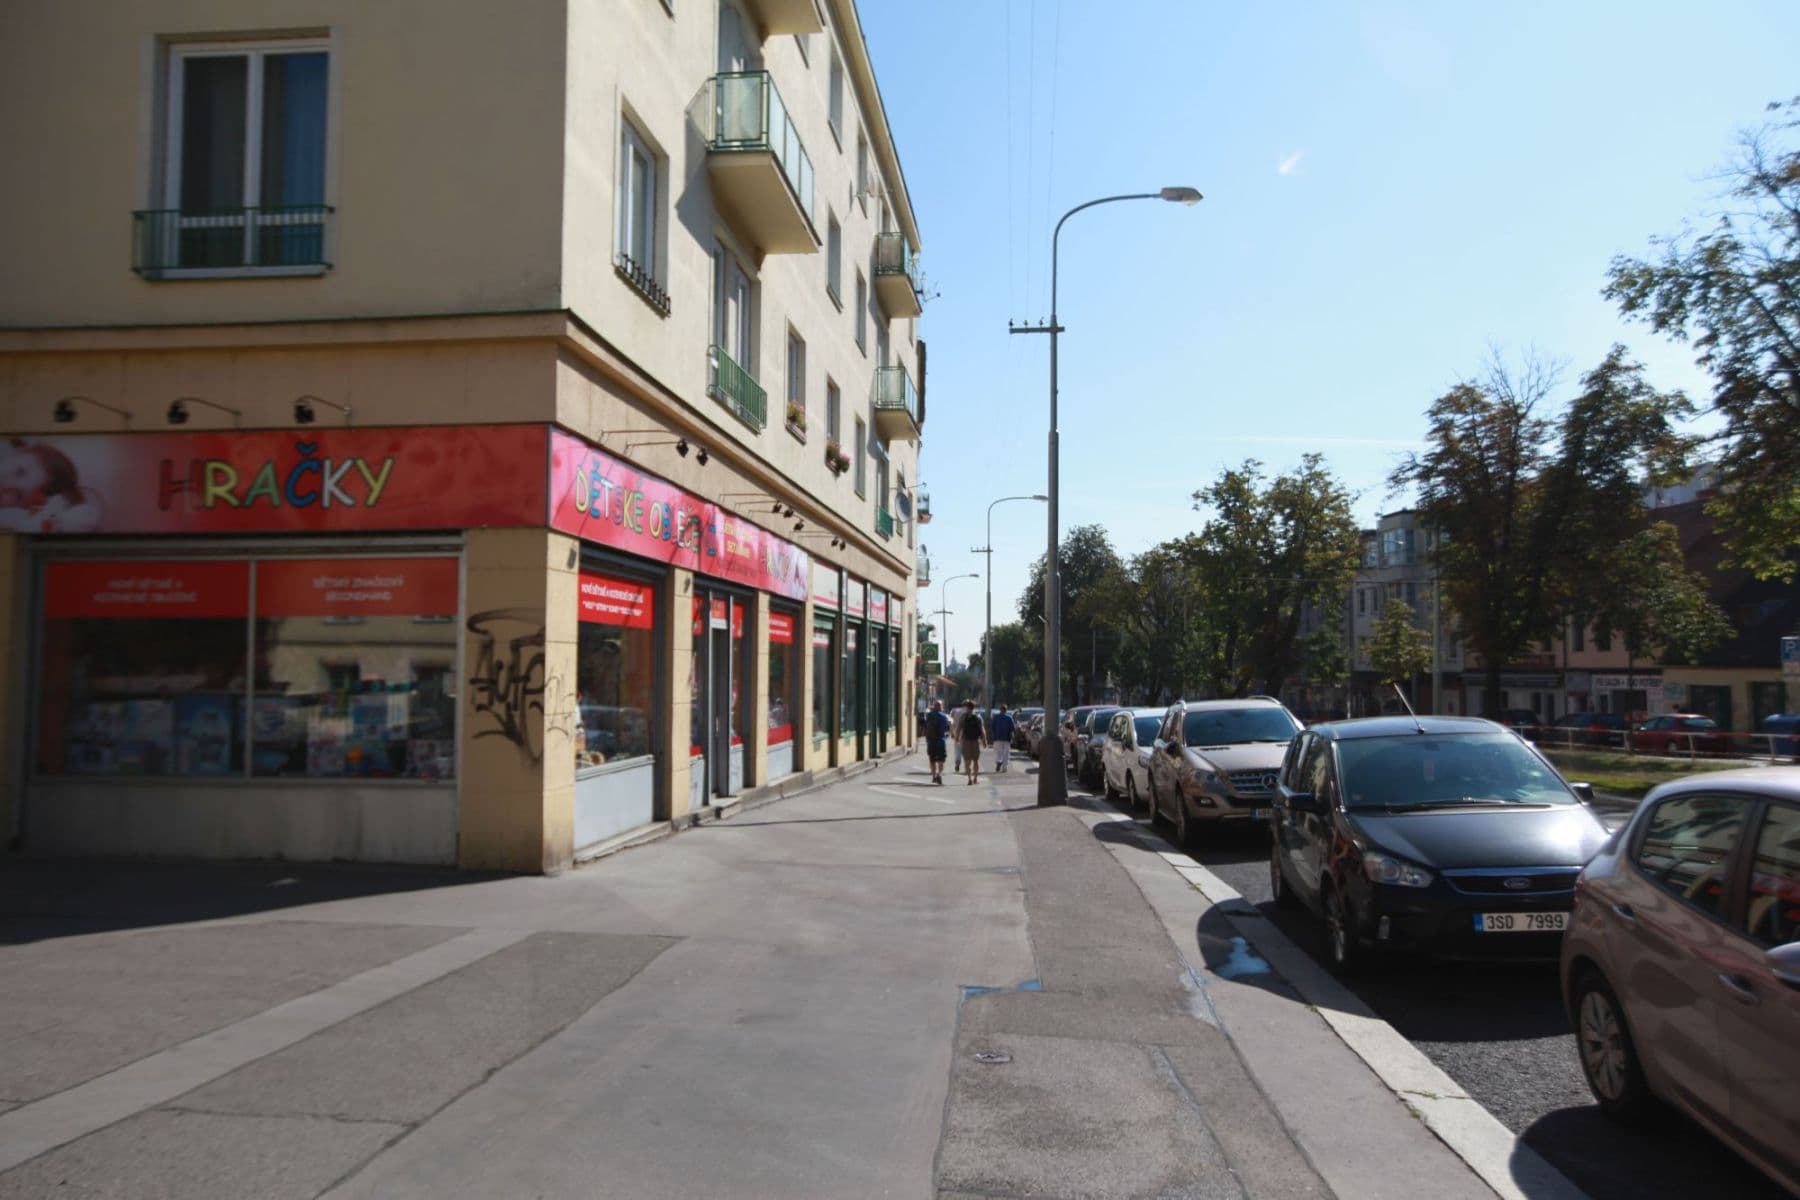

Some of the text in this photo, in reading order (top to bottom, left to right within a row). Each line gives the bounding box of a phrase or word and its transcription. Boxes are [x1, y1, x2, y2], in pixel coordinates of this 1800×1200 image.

[157, 440, 396, 511] HRAČKY
[575, 459, 644, 535] DĚTSKÉ
[1487, 914, 1564, 930] 3SD 7999
